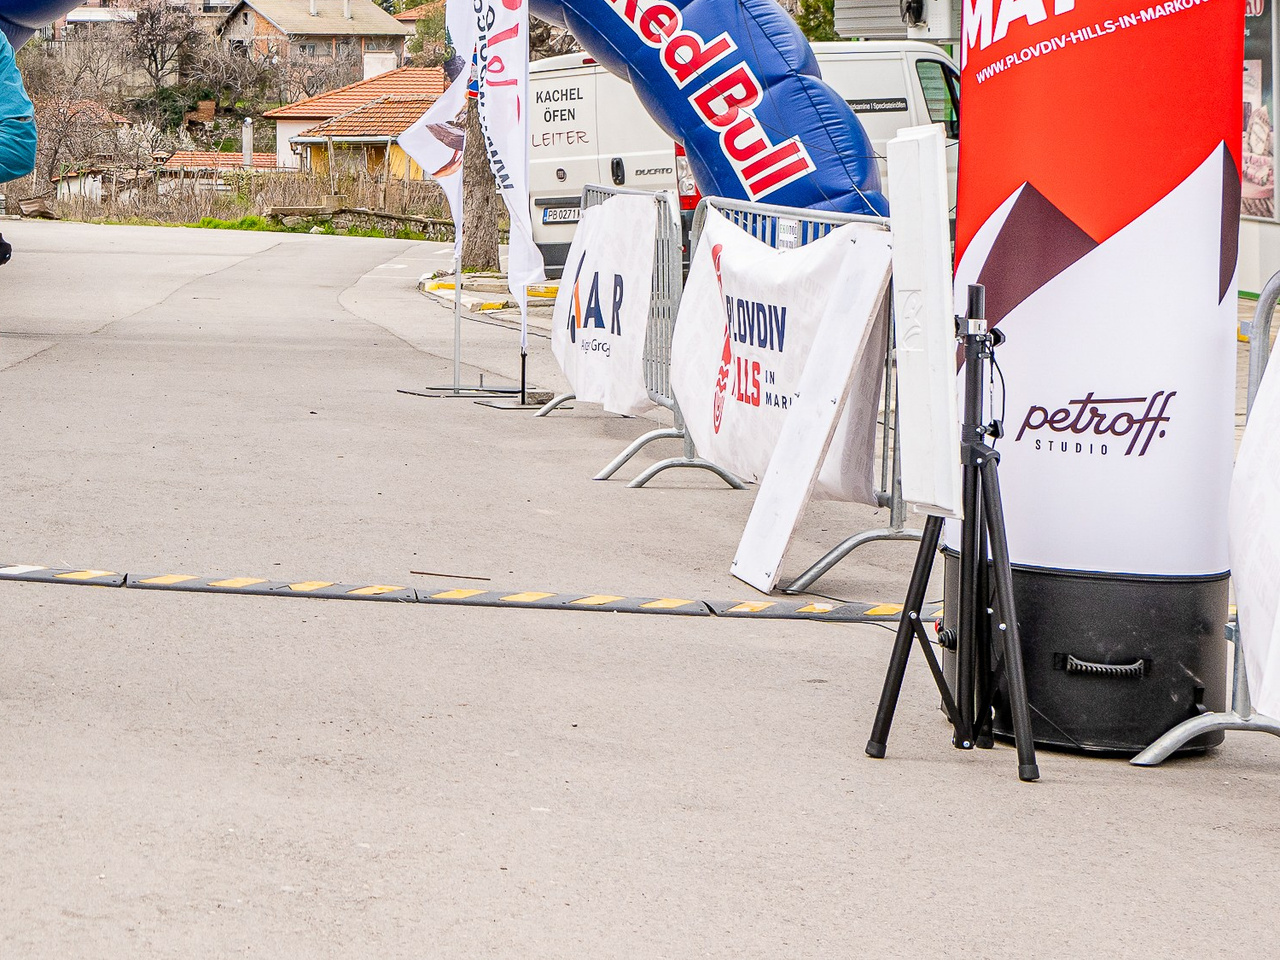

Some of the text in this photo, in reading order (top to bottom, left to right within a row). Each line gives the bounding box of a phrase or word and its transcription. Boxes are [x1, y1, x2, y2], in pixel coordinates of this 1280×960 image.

[536, 88, 583, 103] KACHEL
[544, 107, 575, 122] ÖFEN
[532, 131, 589, 147] LEITER
[690, 62, 813, 200] Bull
[635, 167, 672, 176] DUCATO
[765, 369, 776, 385] IN
[1035, 439, 1108, 455] STUDIO
